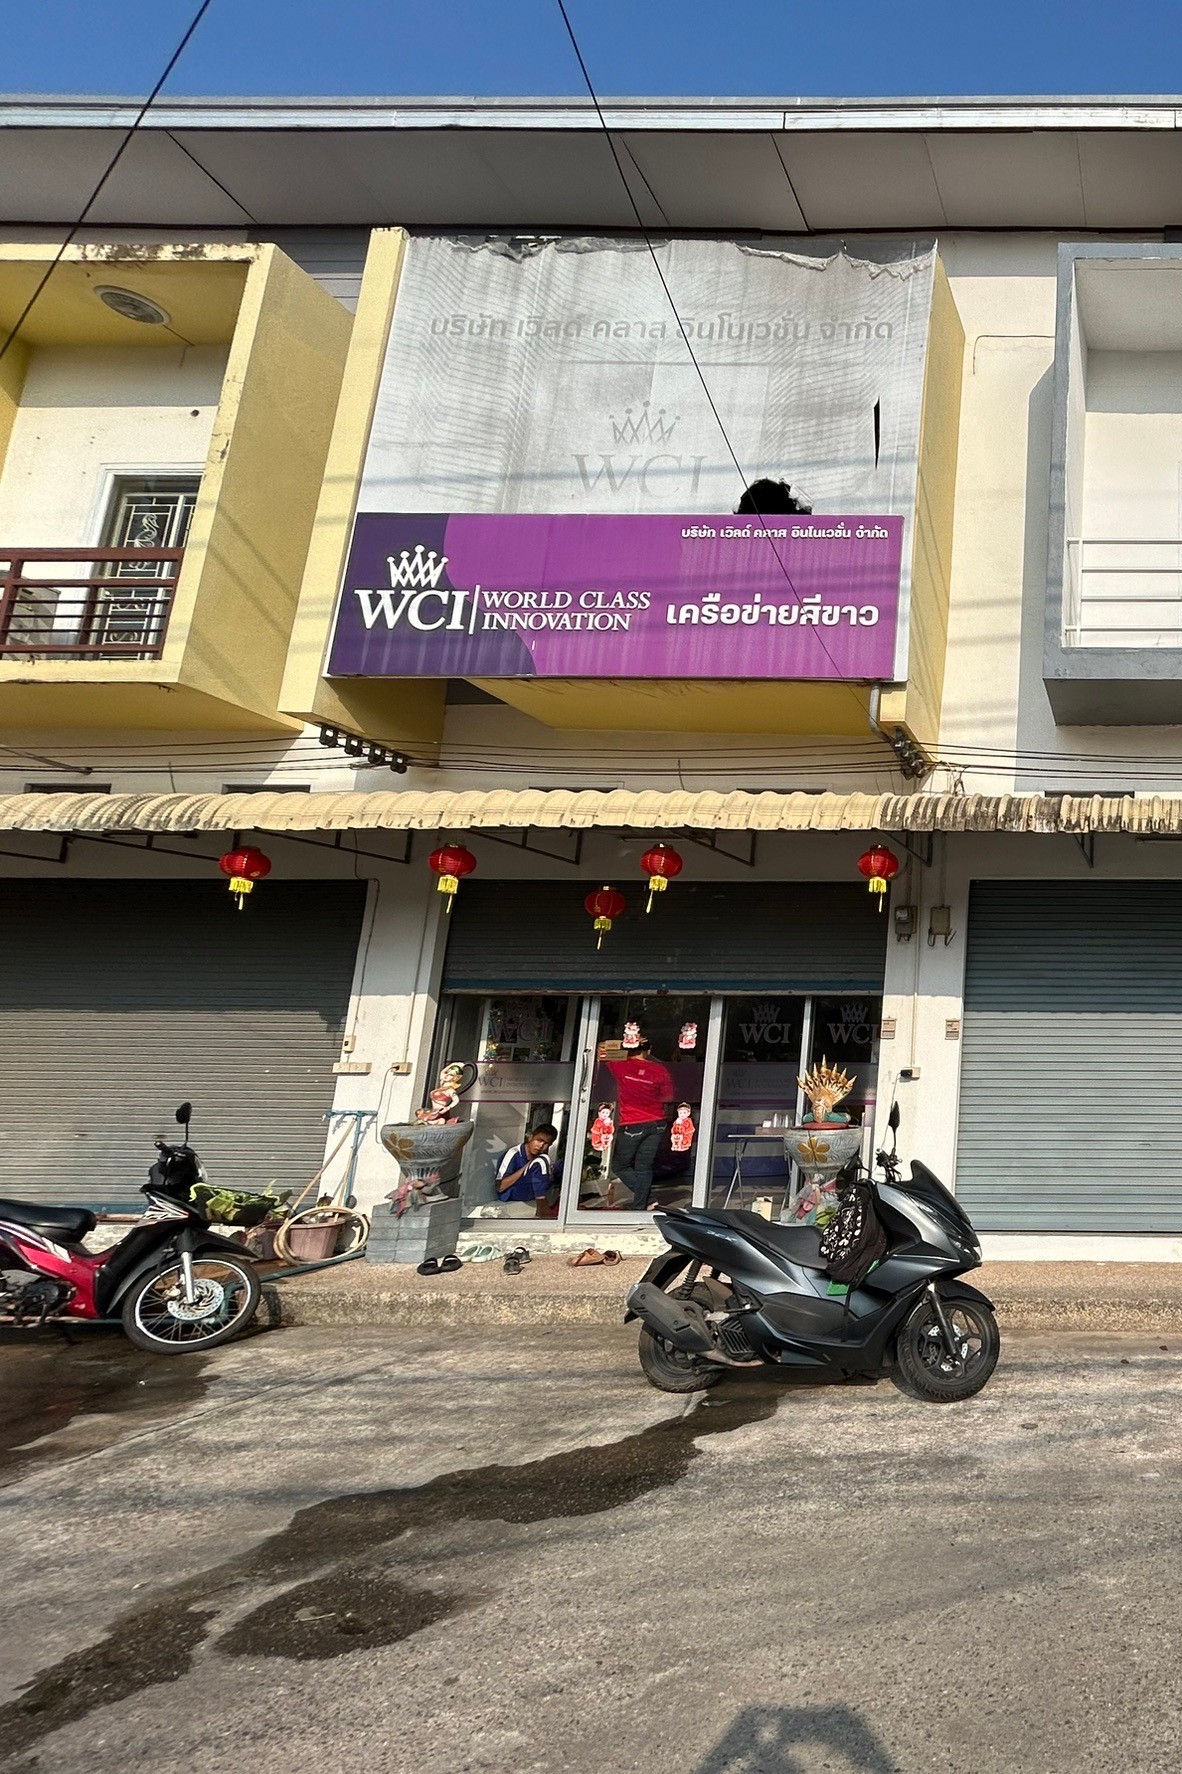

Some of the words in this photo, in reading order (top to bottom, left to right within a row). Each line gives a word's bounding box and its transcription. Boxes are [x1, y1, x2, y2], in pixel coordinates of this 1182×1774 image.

[430, 313, 508, 340] บริษัท
[592, 317, 667, 340] คลาส
[819, 314, 895, 341] จำกัด
[571, 453, 708, 499] WCI
[681, 525, 716, 539] บริษัท
[720, 524, 752, 539] เวิลด์
[791, 522, 851, 539] อินโนเวชั่น
[856, 525, 888, 539] จำกัด
[354, 589, 470, 631] WCI
[481, 591, 573, 610] WORLD
[579, 591, 651, 611] CLASS
[666, 592, 880, 627] เครือข่ายสีขาว
[481, 613, 632, 631] INNOVATION
[490, 1016, 552, 1043] WCI
[739, 1022, 791, 1044] WCI
[827, 1022, 881, 1044] WCI
